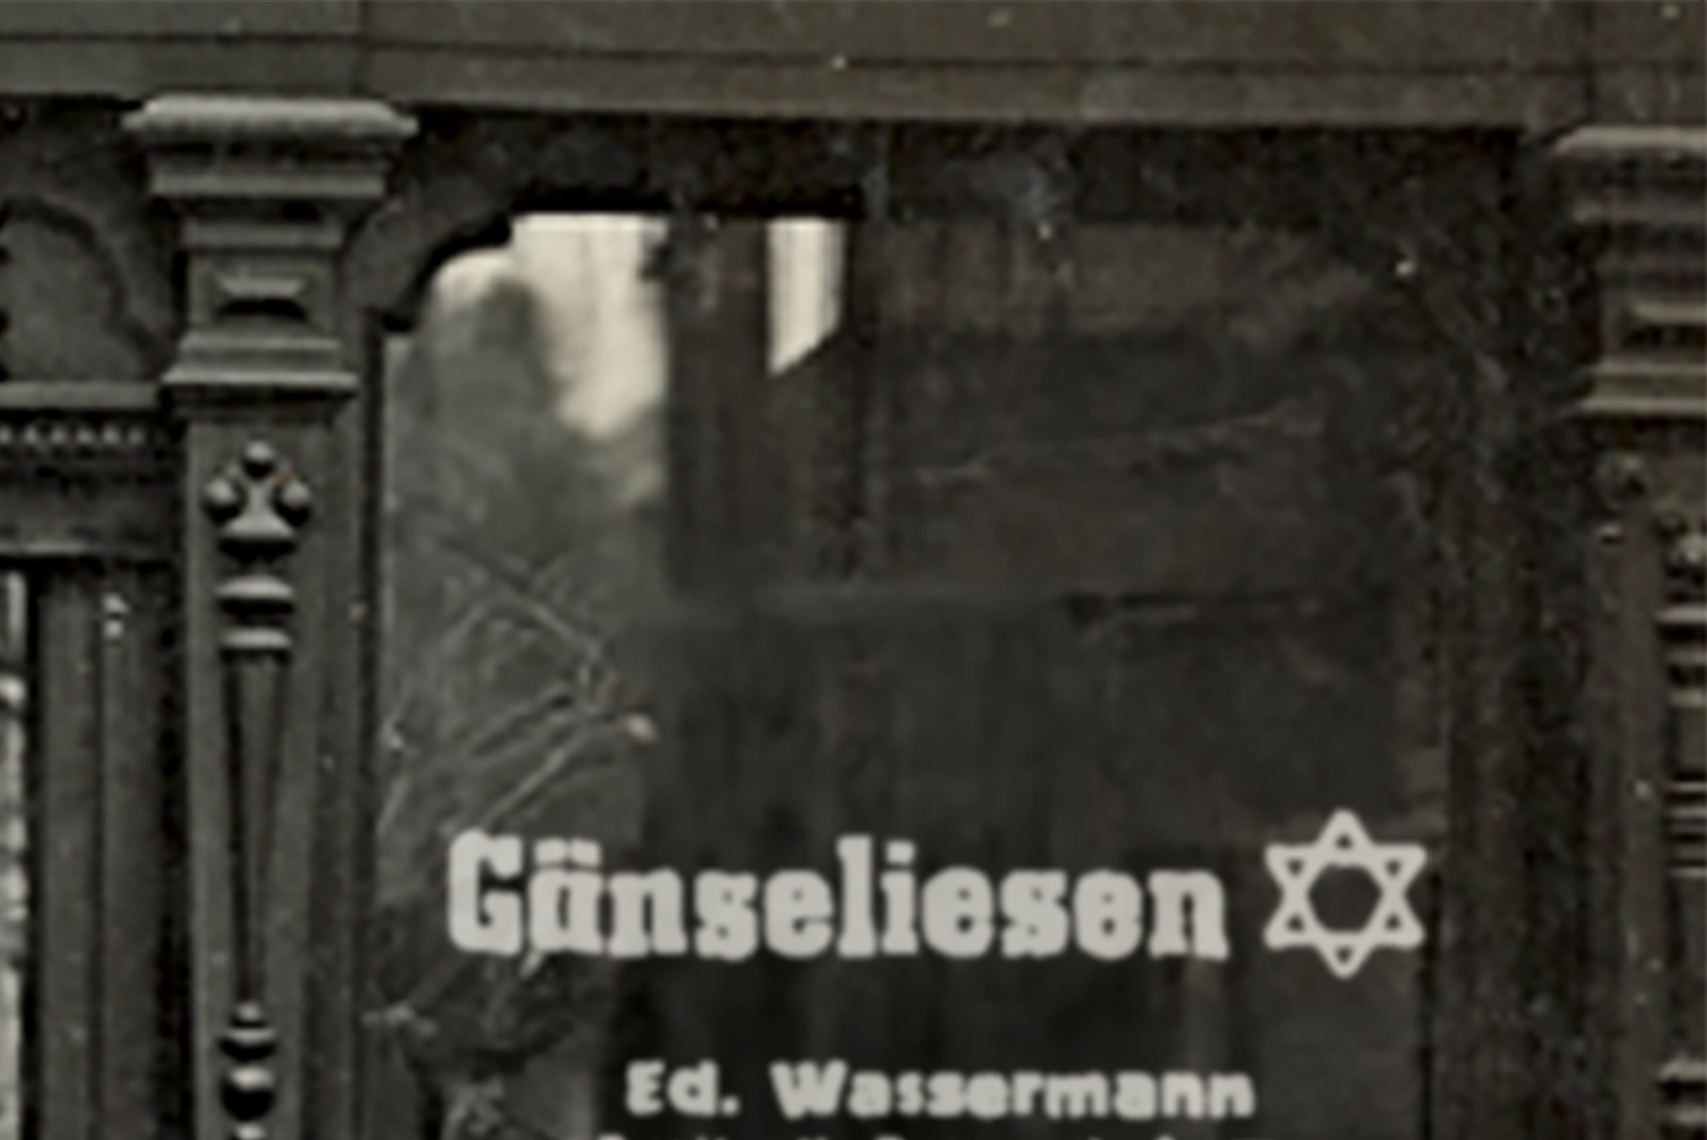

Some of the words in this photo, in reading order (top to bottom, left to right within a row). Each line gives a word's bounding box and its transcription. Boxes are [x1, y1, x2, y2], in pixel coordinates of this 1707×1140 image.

[448, 829, 1229, 961] Gänseliesen
[626, 1059, 740, 1117] Ed.
[769, 1059, 1255, 1121] Wassermann
